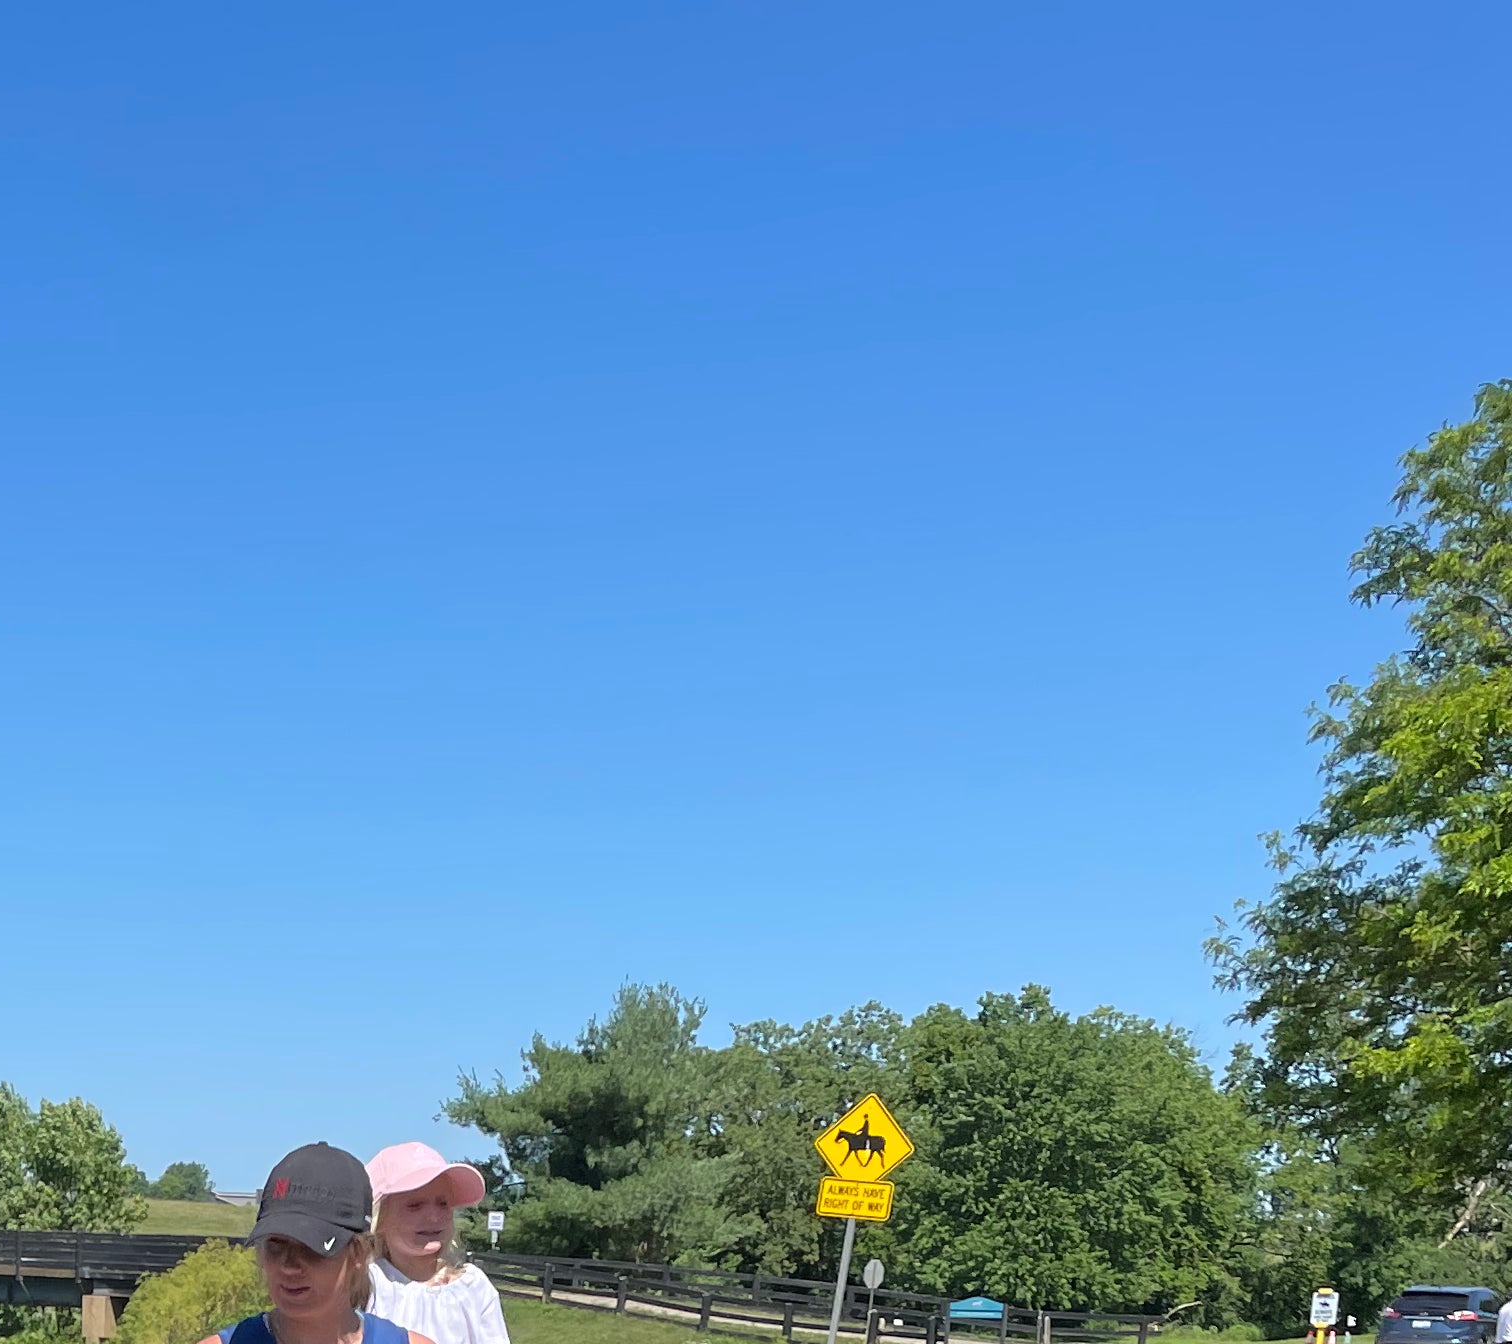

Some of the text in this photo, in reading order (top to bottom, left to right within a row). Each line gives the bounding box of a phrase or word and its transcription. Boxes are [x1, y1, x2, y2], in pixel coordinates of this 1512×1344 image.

[826, 1184, 886, 1199] ALWAYS HAVE
[823, 1197, 885, 1212] RIGHT OF WAY
